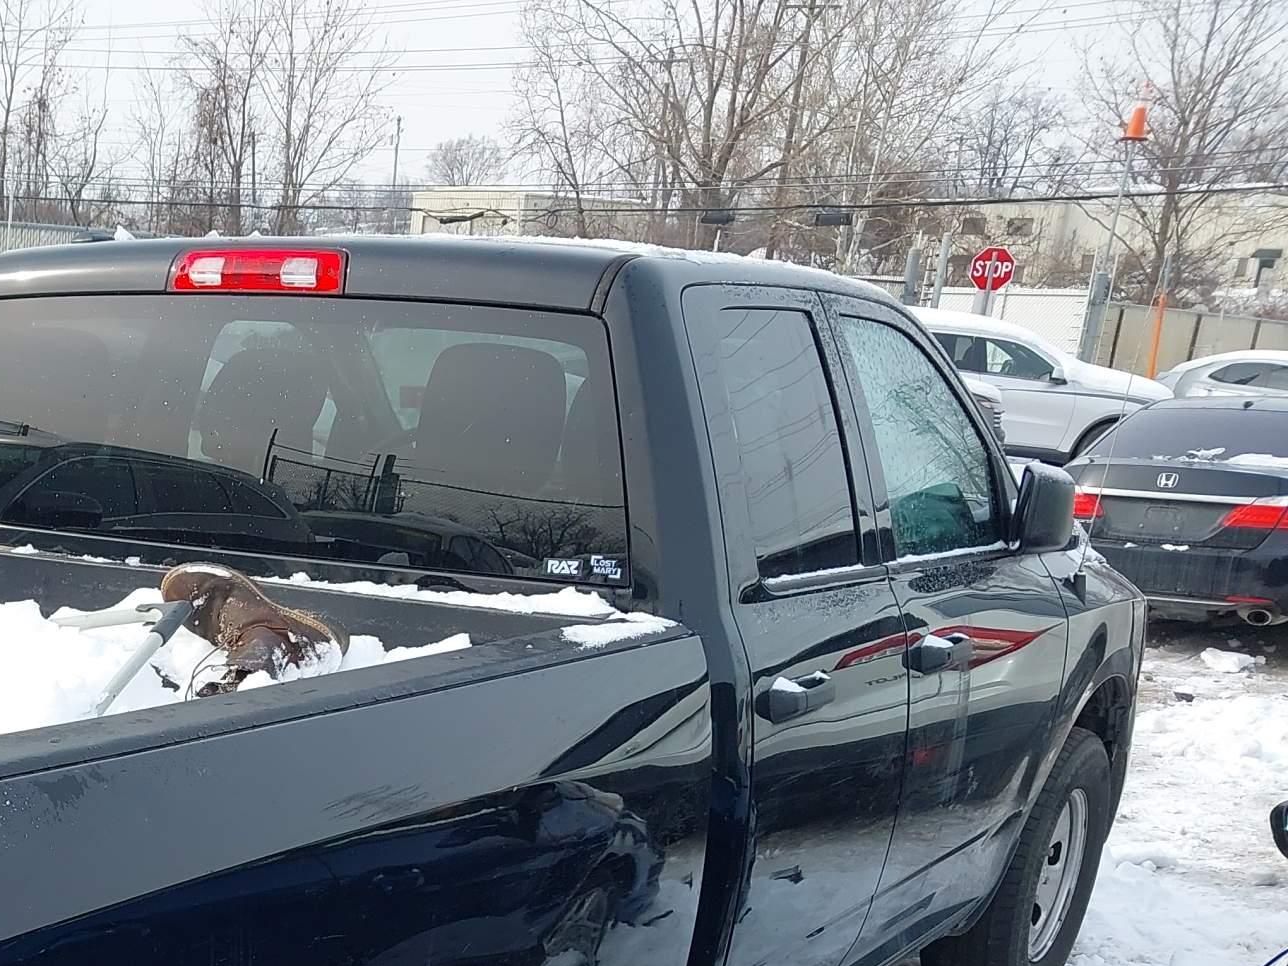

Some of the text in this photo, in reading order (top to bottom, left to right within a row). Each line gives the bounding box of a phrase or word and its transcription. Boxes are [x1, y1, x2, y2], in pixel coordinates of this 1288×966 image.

[973, 260, 1012, 279] STOP
[546, 559, 579, 575] RAZ
[593, 559, 617, 567] LOST
[593, 567, 617, 575] MARY
